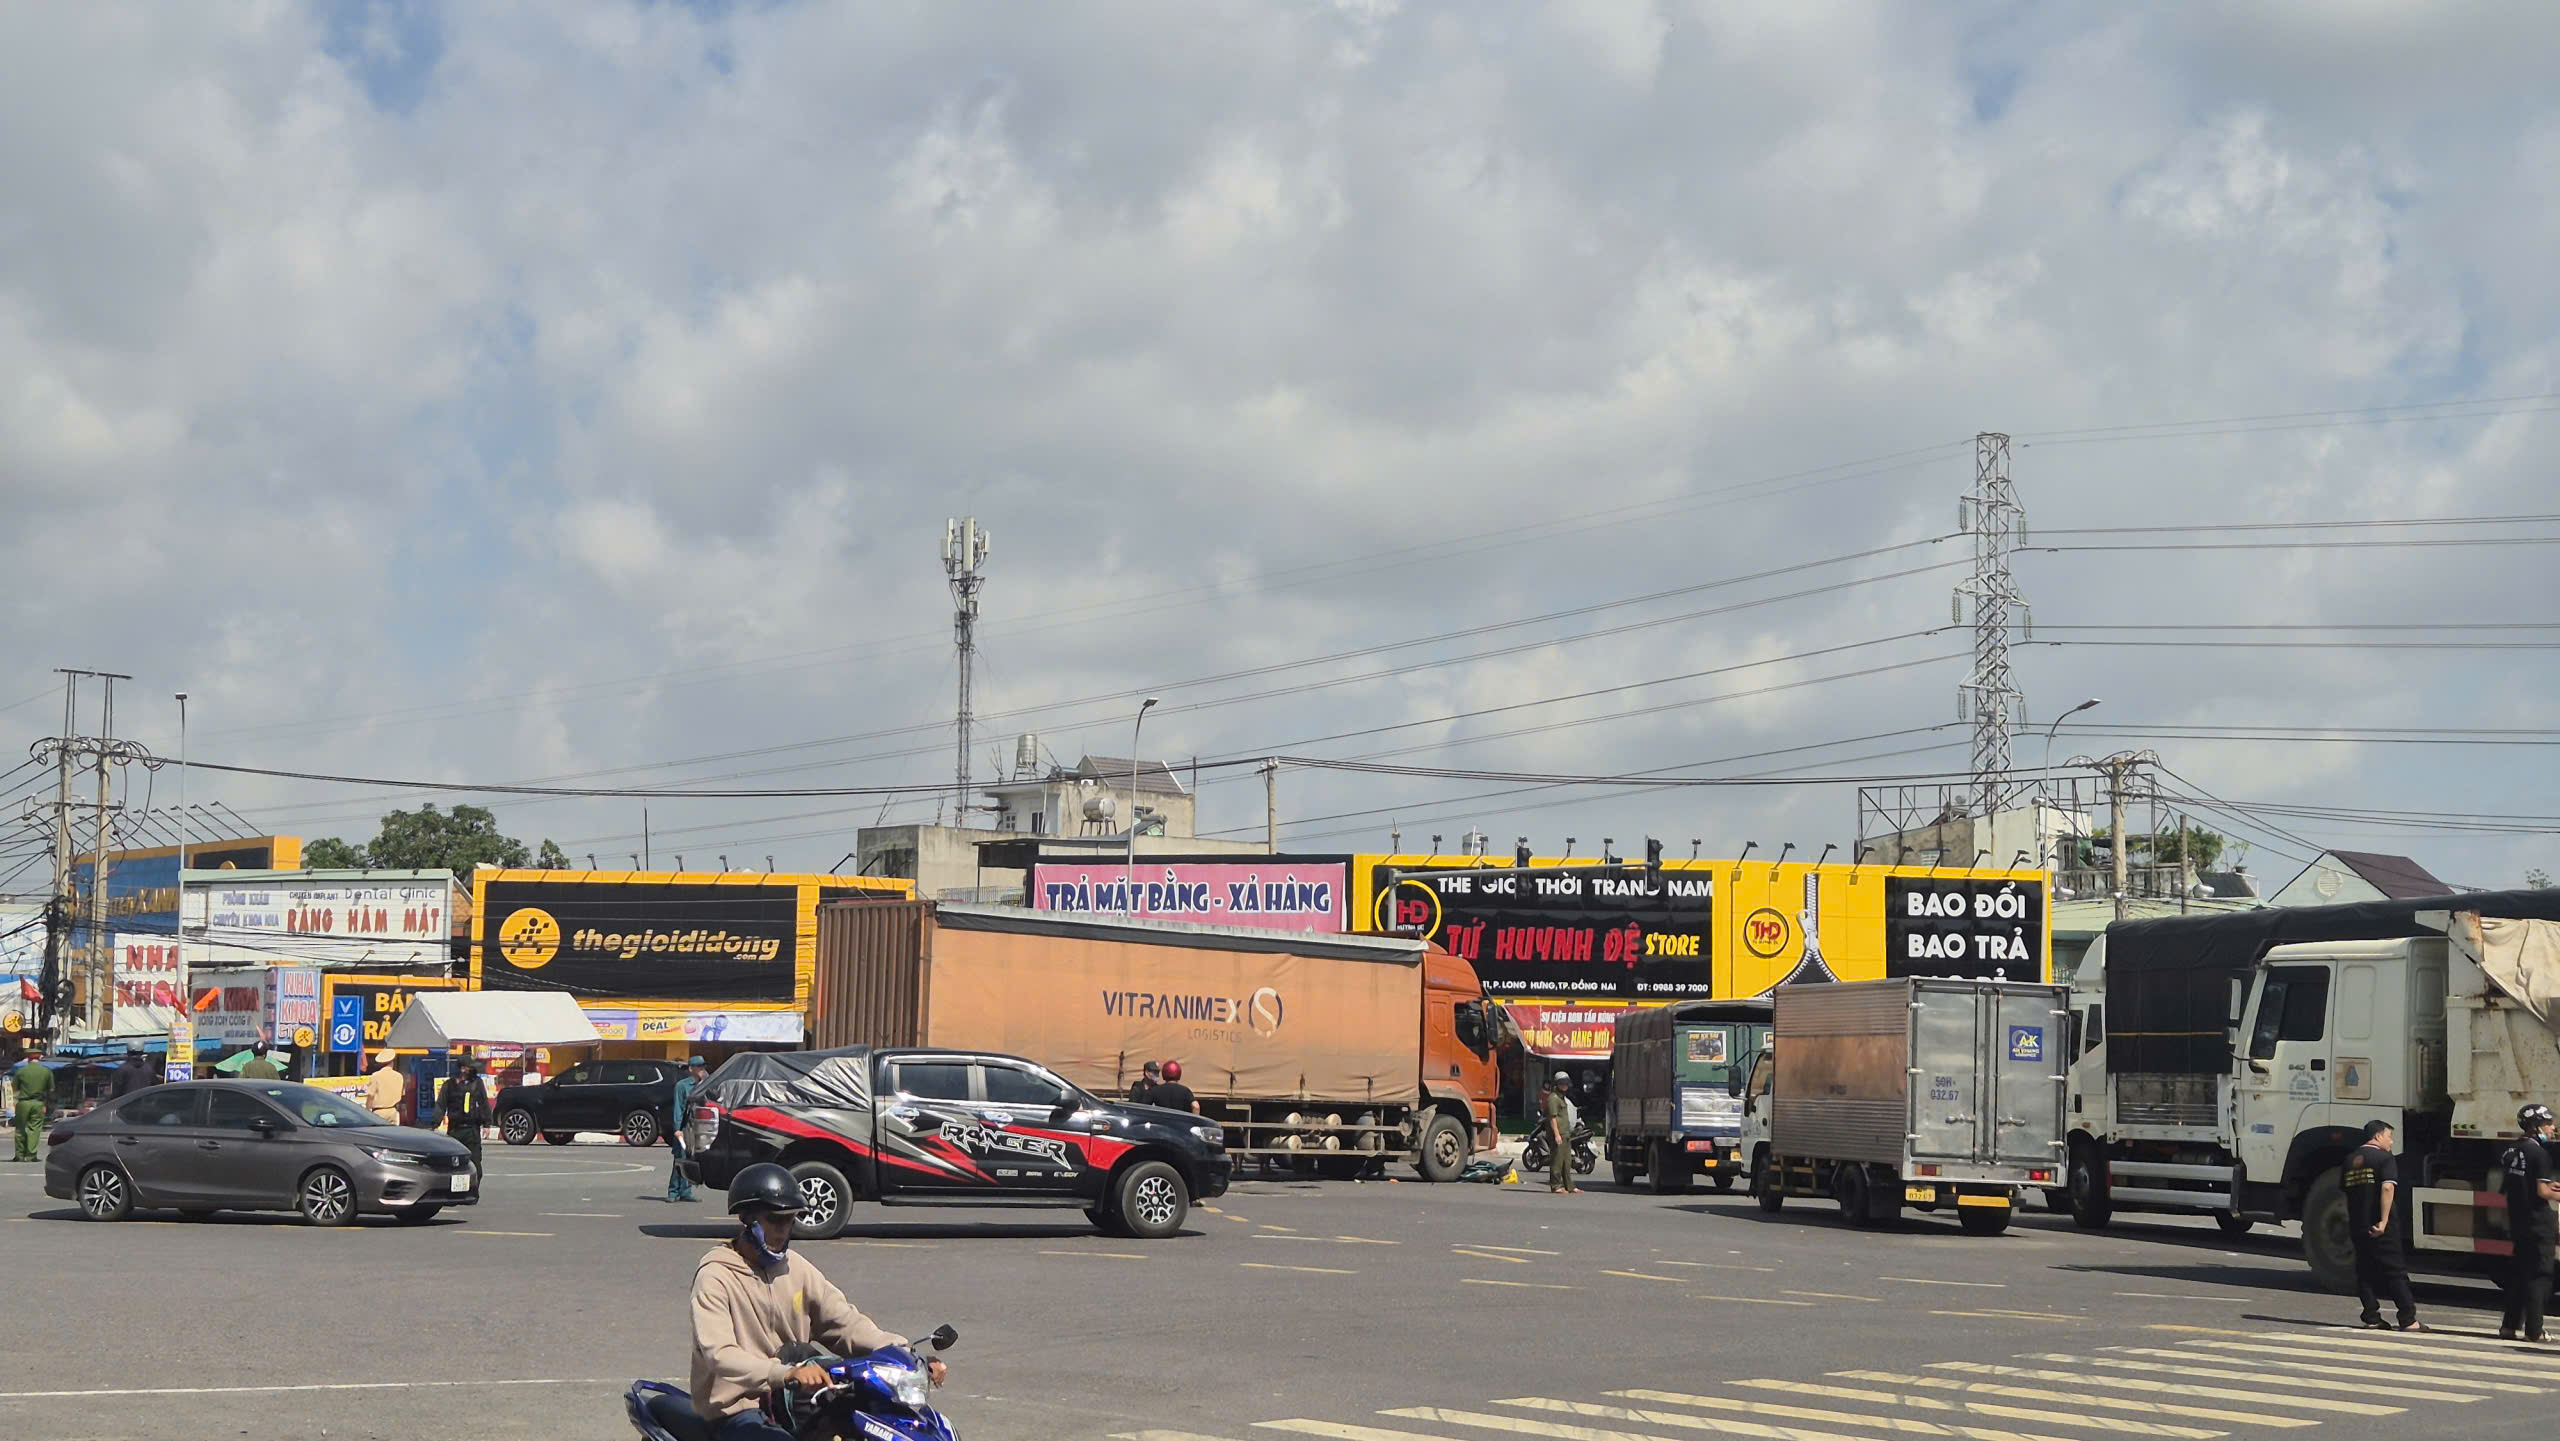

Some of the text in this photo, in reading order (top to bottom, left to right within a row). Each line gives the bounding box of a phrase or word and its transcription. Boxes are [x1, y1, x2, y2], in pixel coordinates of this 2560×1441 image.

[344, 887, 392, 900] Dental
[1046, 875, 1089, 912] TRẢ
[1148, 869, 1209, 912] BẰNG
[1229, 874, 1257, 912] XẢ
[1264, 875, 1331, 912] HÀNG
[1535, 871, 1582, 895] THỜI
[1668, 880, 1712, 897] NAM
[1907, 881, 2026, 919] BAO ĐỔI
[403, 902, 440, 938] MẶT
[573, 928, 781, 961] thegioididong
[1603, 922, 1642, 969] ĐỆ
[1645, 932, 1700, 956] STORE
[1908, 927, 2029, 960] BAO TRẢ
[1502, 980, 1527, 989] LONG
[1600, 982, 1617, 991] NAI
[1688, 984, 1709, 992] 7000
[1102, 990, 1242, 1024] VITRANIMEX
[363, 1014, 393, 1040] RẢ
[1187, 1028, 1243, 1044] LOGISTICS
[169, 1069, 190, 1081] 10%
[939, 1121, 1072, 1170] RANGER
[864, 1421, 894, 1441] YAMAHA
